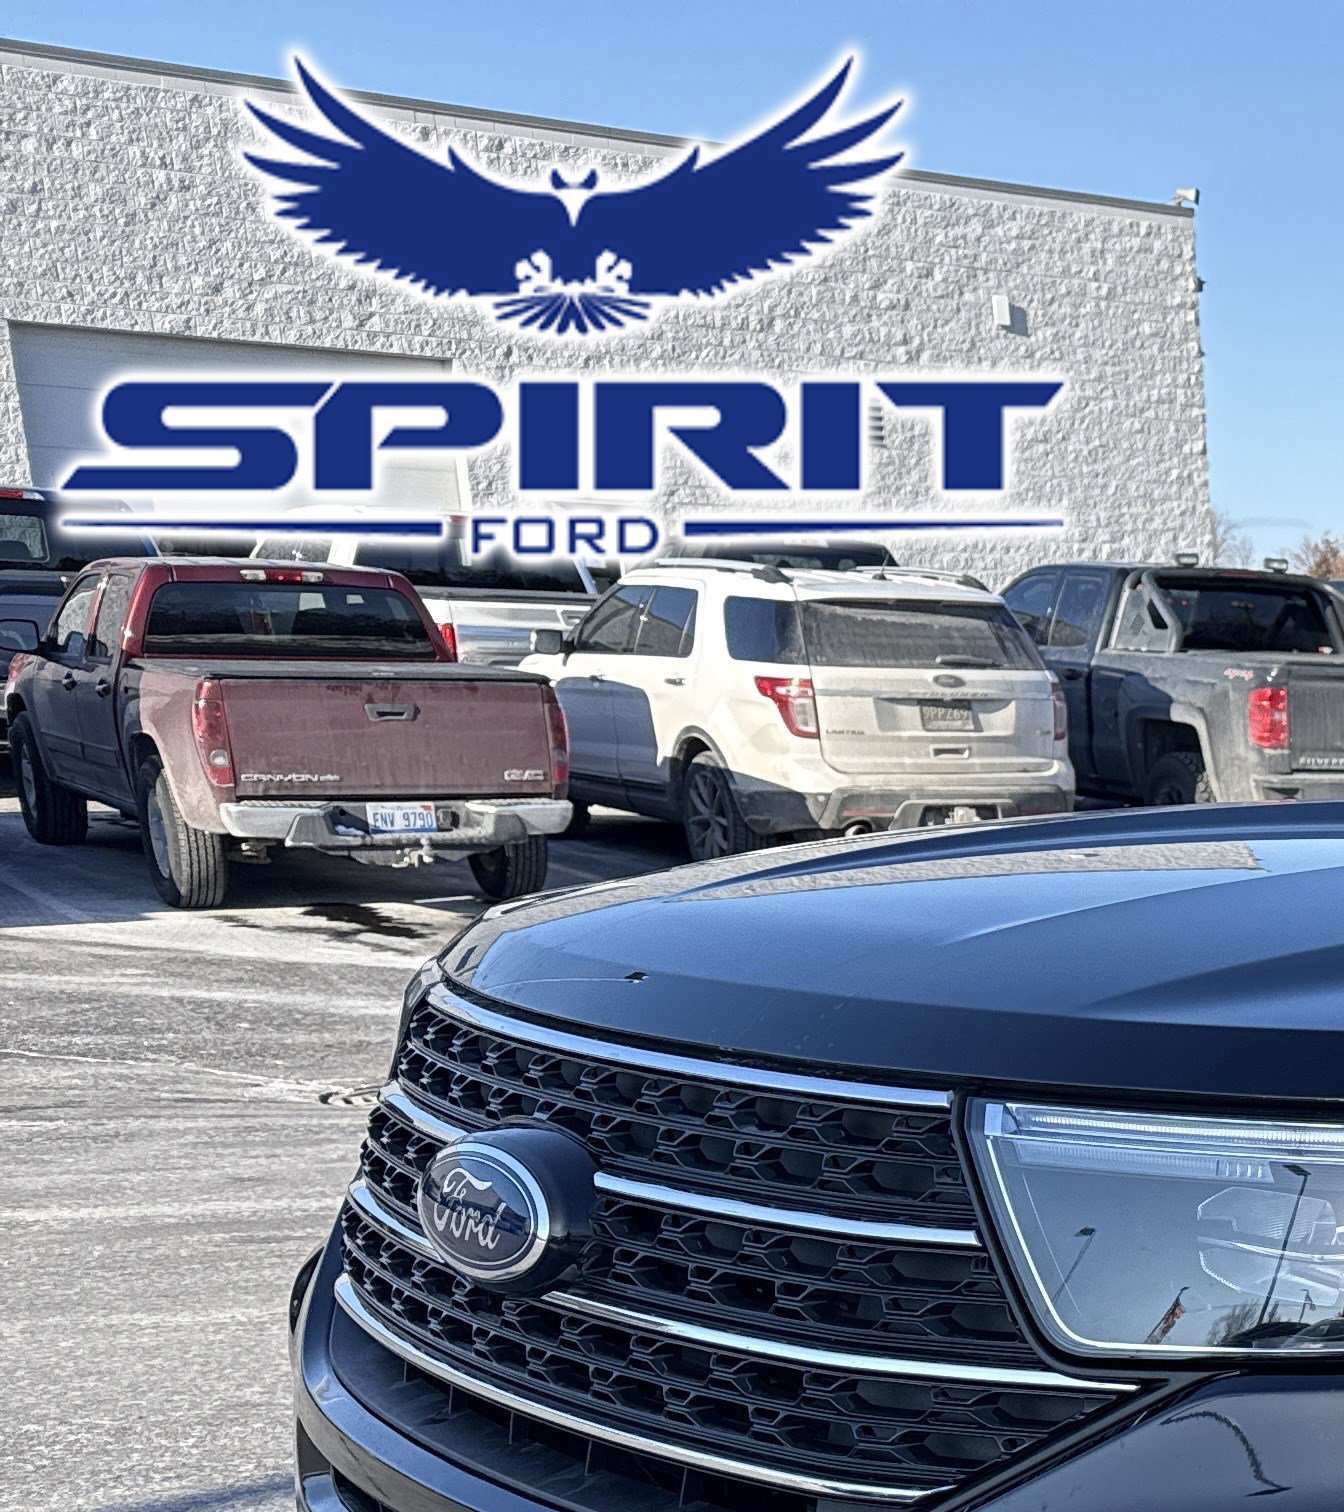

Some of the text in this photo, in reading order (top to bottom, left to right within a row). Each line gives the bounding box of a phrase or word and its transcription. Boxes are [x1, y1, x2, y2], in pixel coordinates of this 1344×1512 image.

[240, 773, 319, 782] CANYON
[373, 812, 434, 828] ENV 9790
[433, 1167, 507, 1249] Ford
